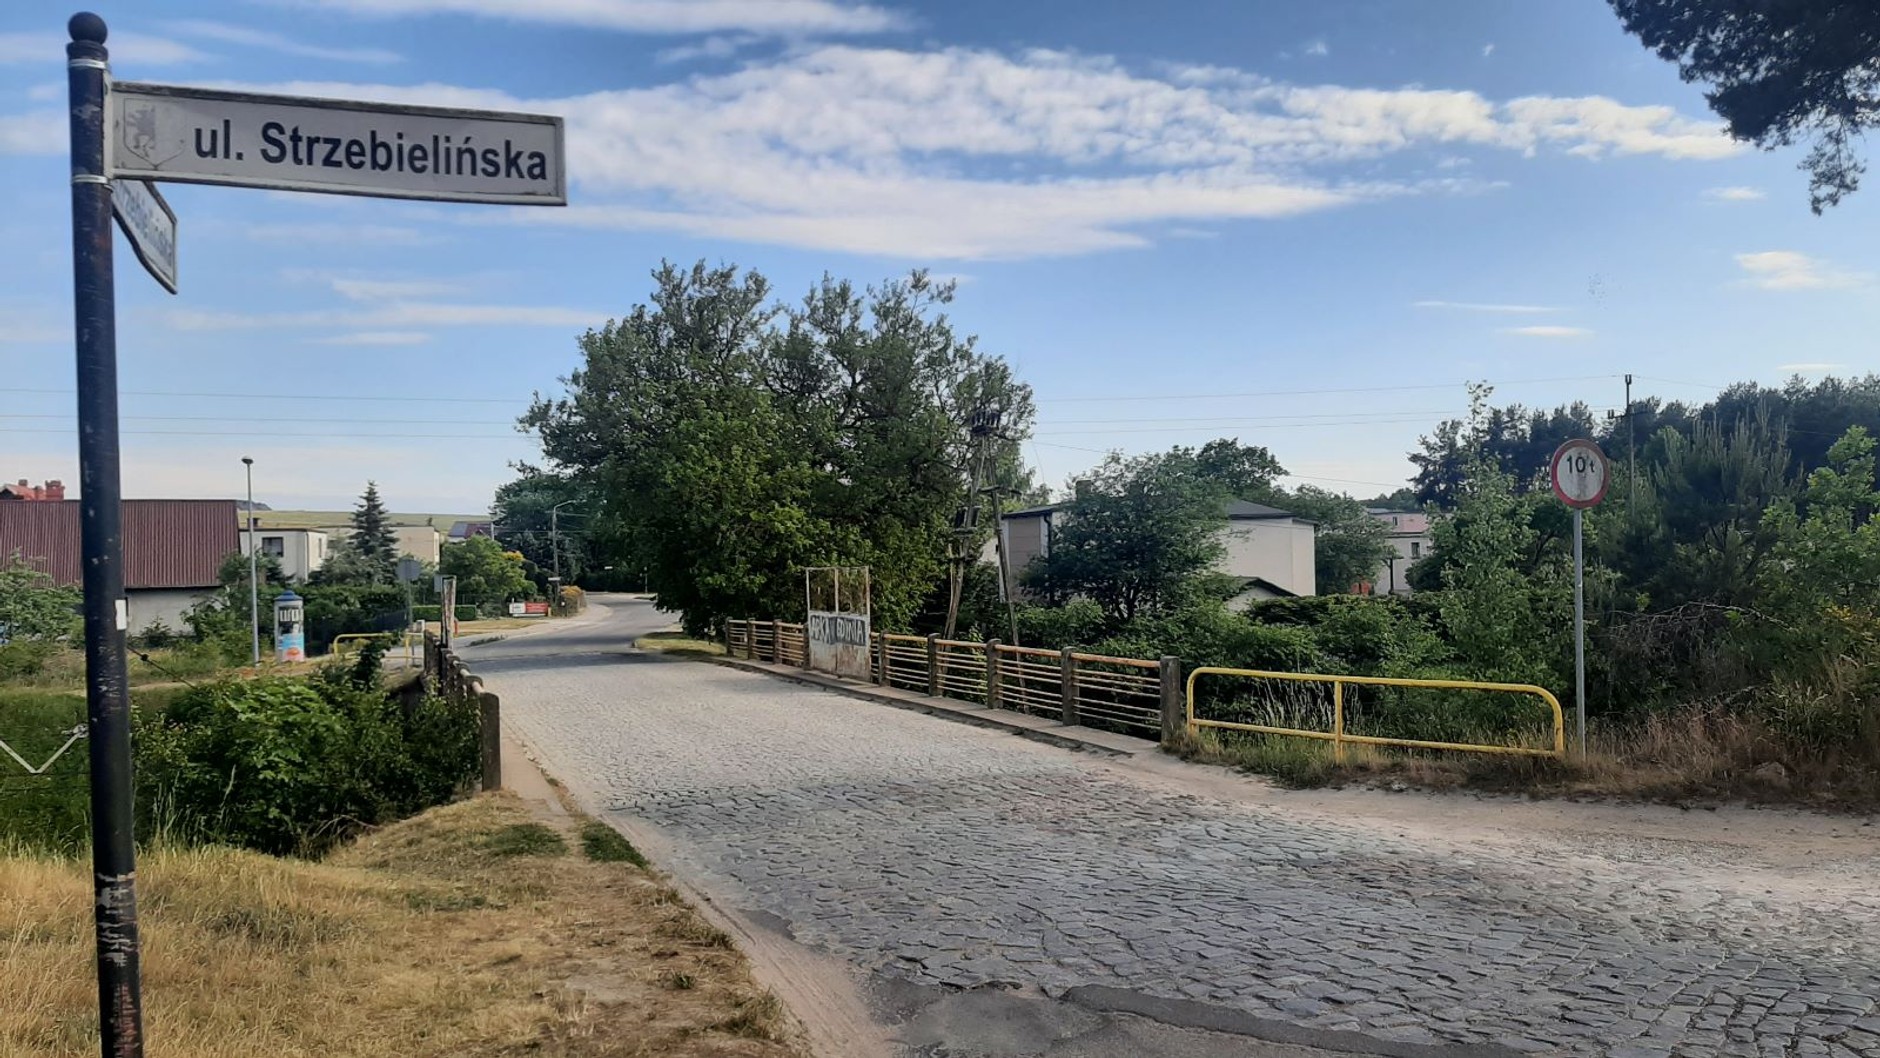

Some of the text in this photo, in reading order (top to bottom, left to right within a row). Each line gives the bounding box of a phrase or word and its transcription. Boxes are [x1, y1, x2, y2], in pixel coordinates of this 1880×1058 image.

[194, 119, 548, 180] ul. Strzebielińska
[1567, 455, 1586, 474] 10
